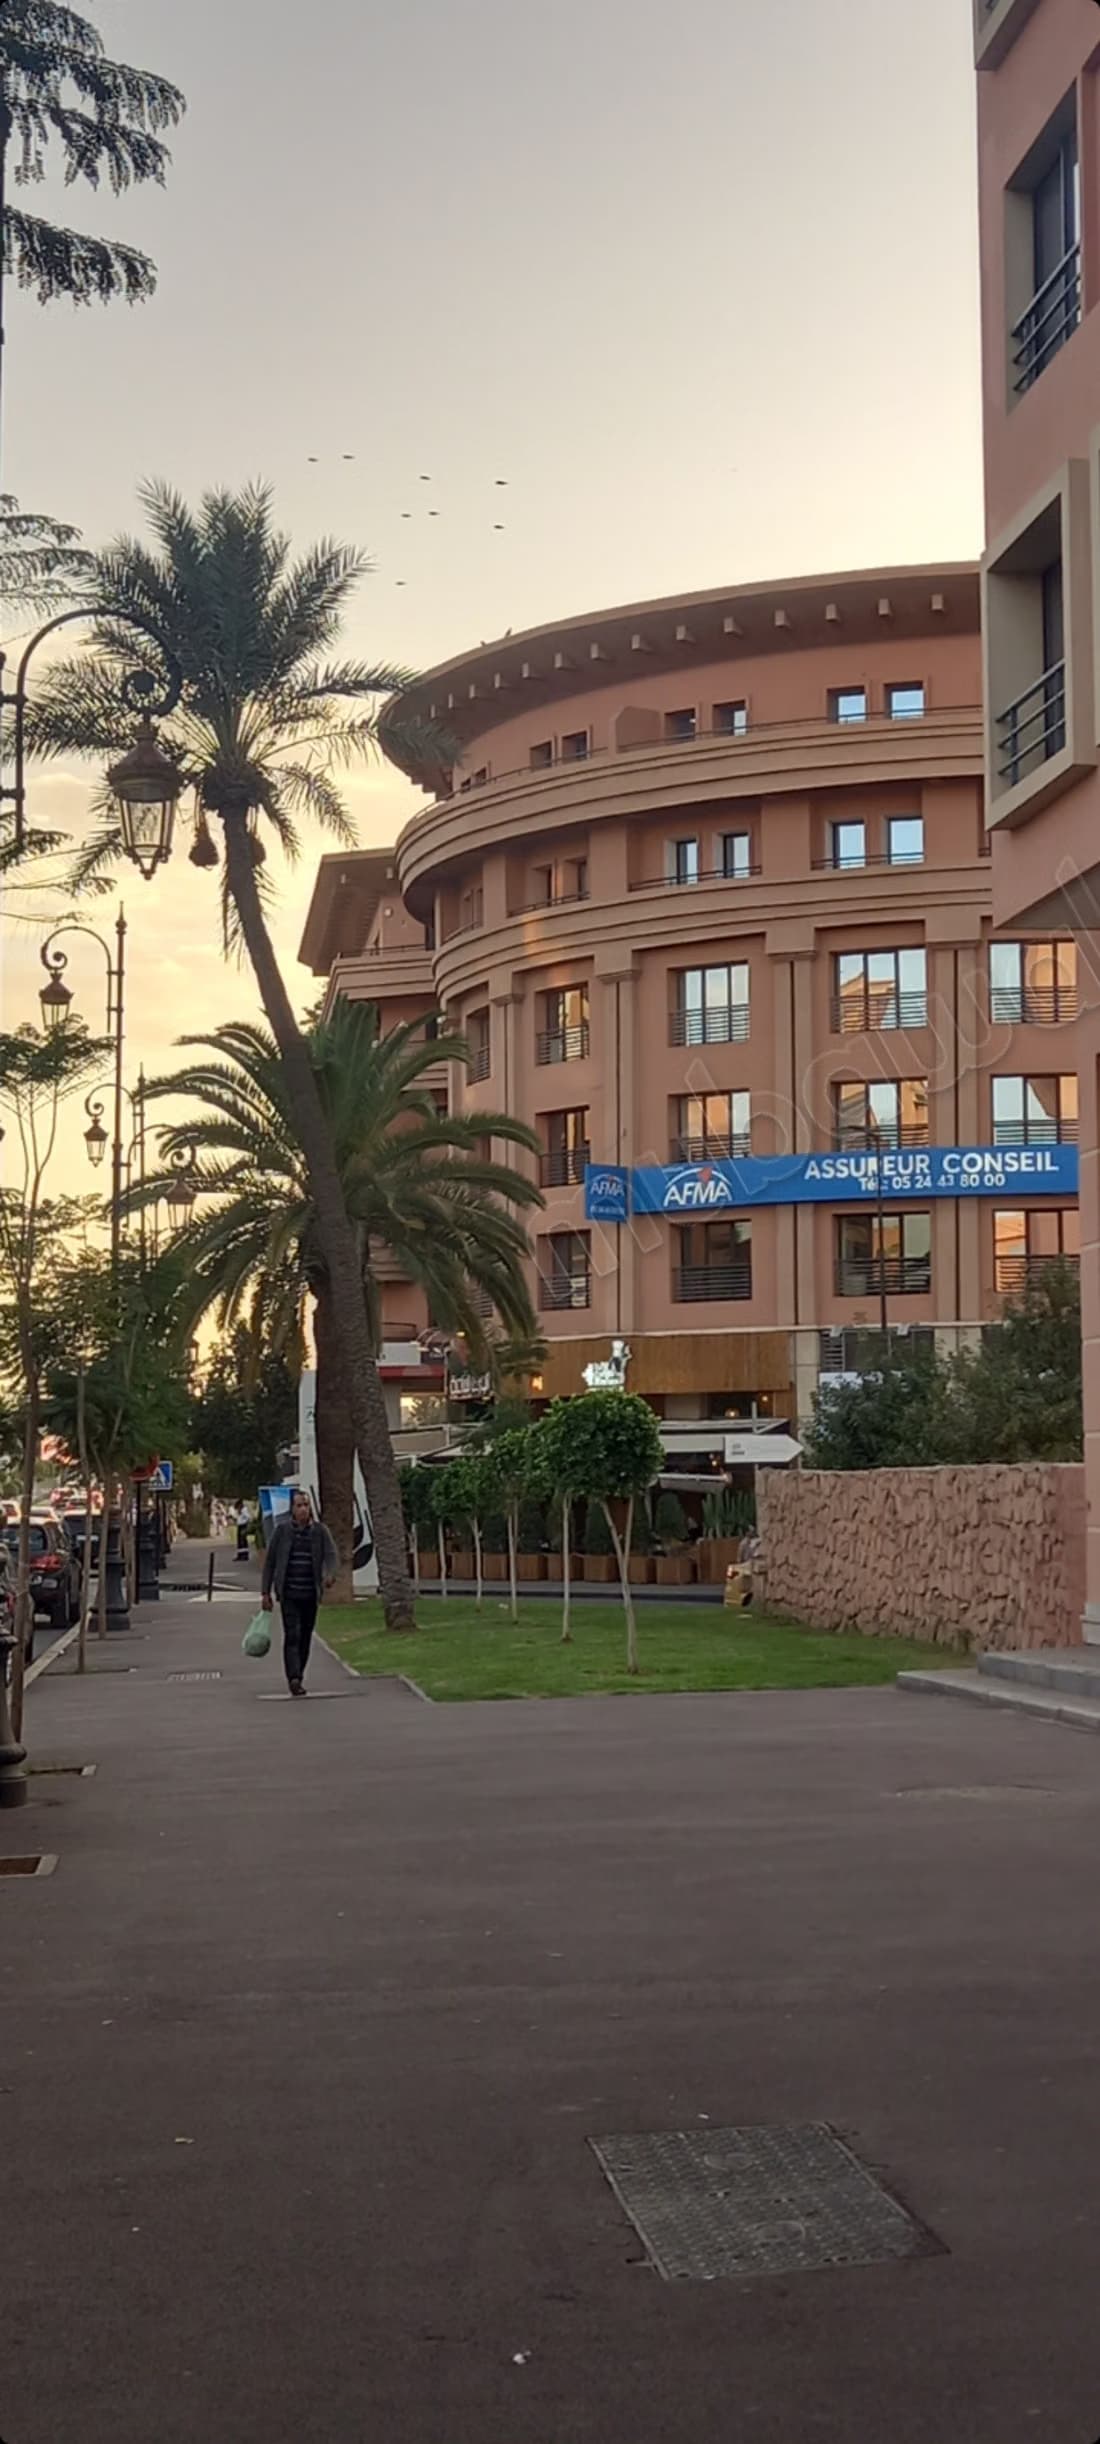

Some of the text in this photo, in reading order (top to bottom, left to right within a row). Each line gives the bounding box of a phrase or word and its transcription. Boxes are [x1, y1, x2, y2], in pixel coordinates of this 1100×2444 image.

[804, 1151, 1060, 1180] ASSUREUR CONSEIL
[589, 1180, 625, 1197] AFMA
[892, 1176, 911, 1189] 05
[914, 1176, 932, 1189] 24
[960, 1174, 980, 1188] 80
[983, 1173, 1006, 1187] 00
[663, 1180, 734, 1208] AFMA
